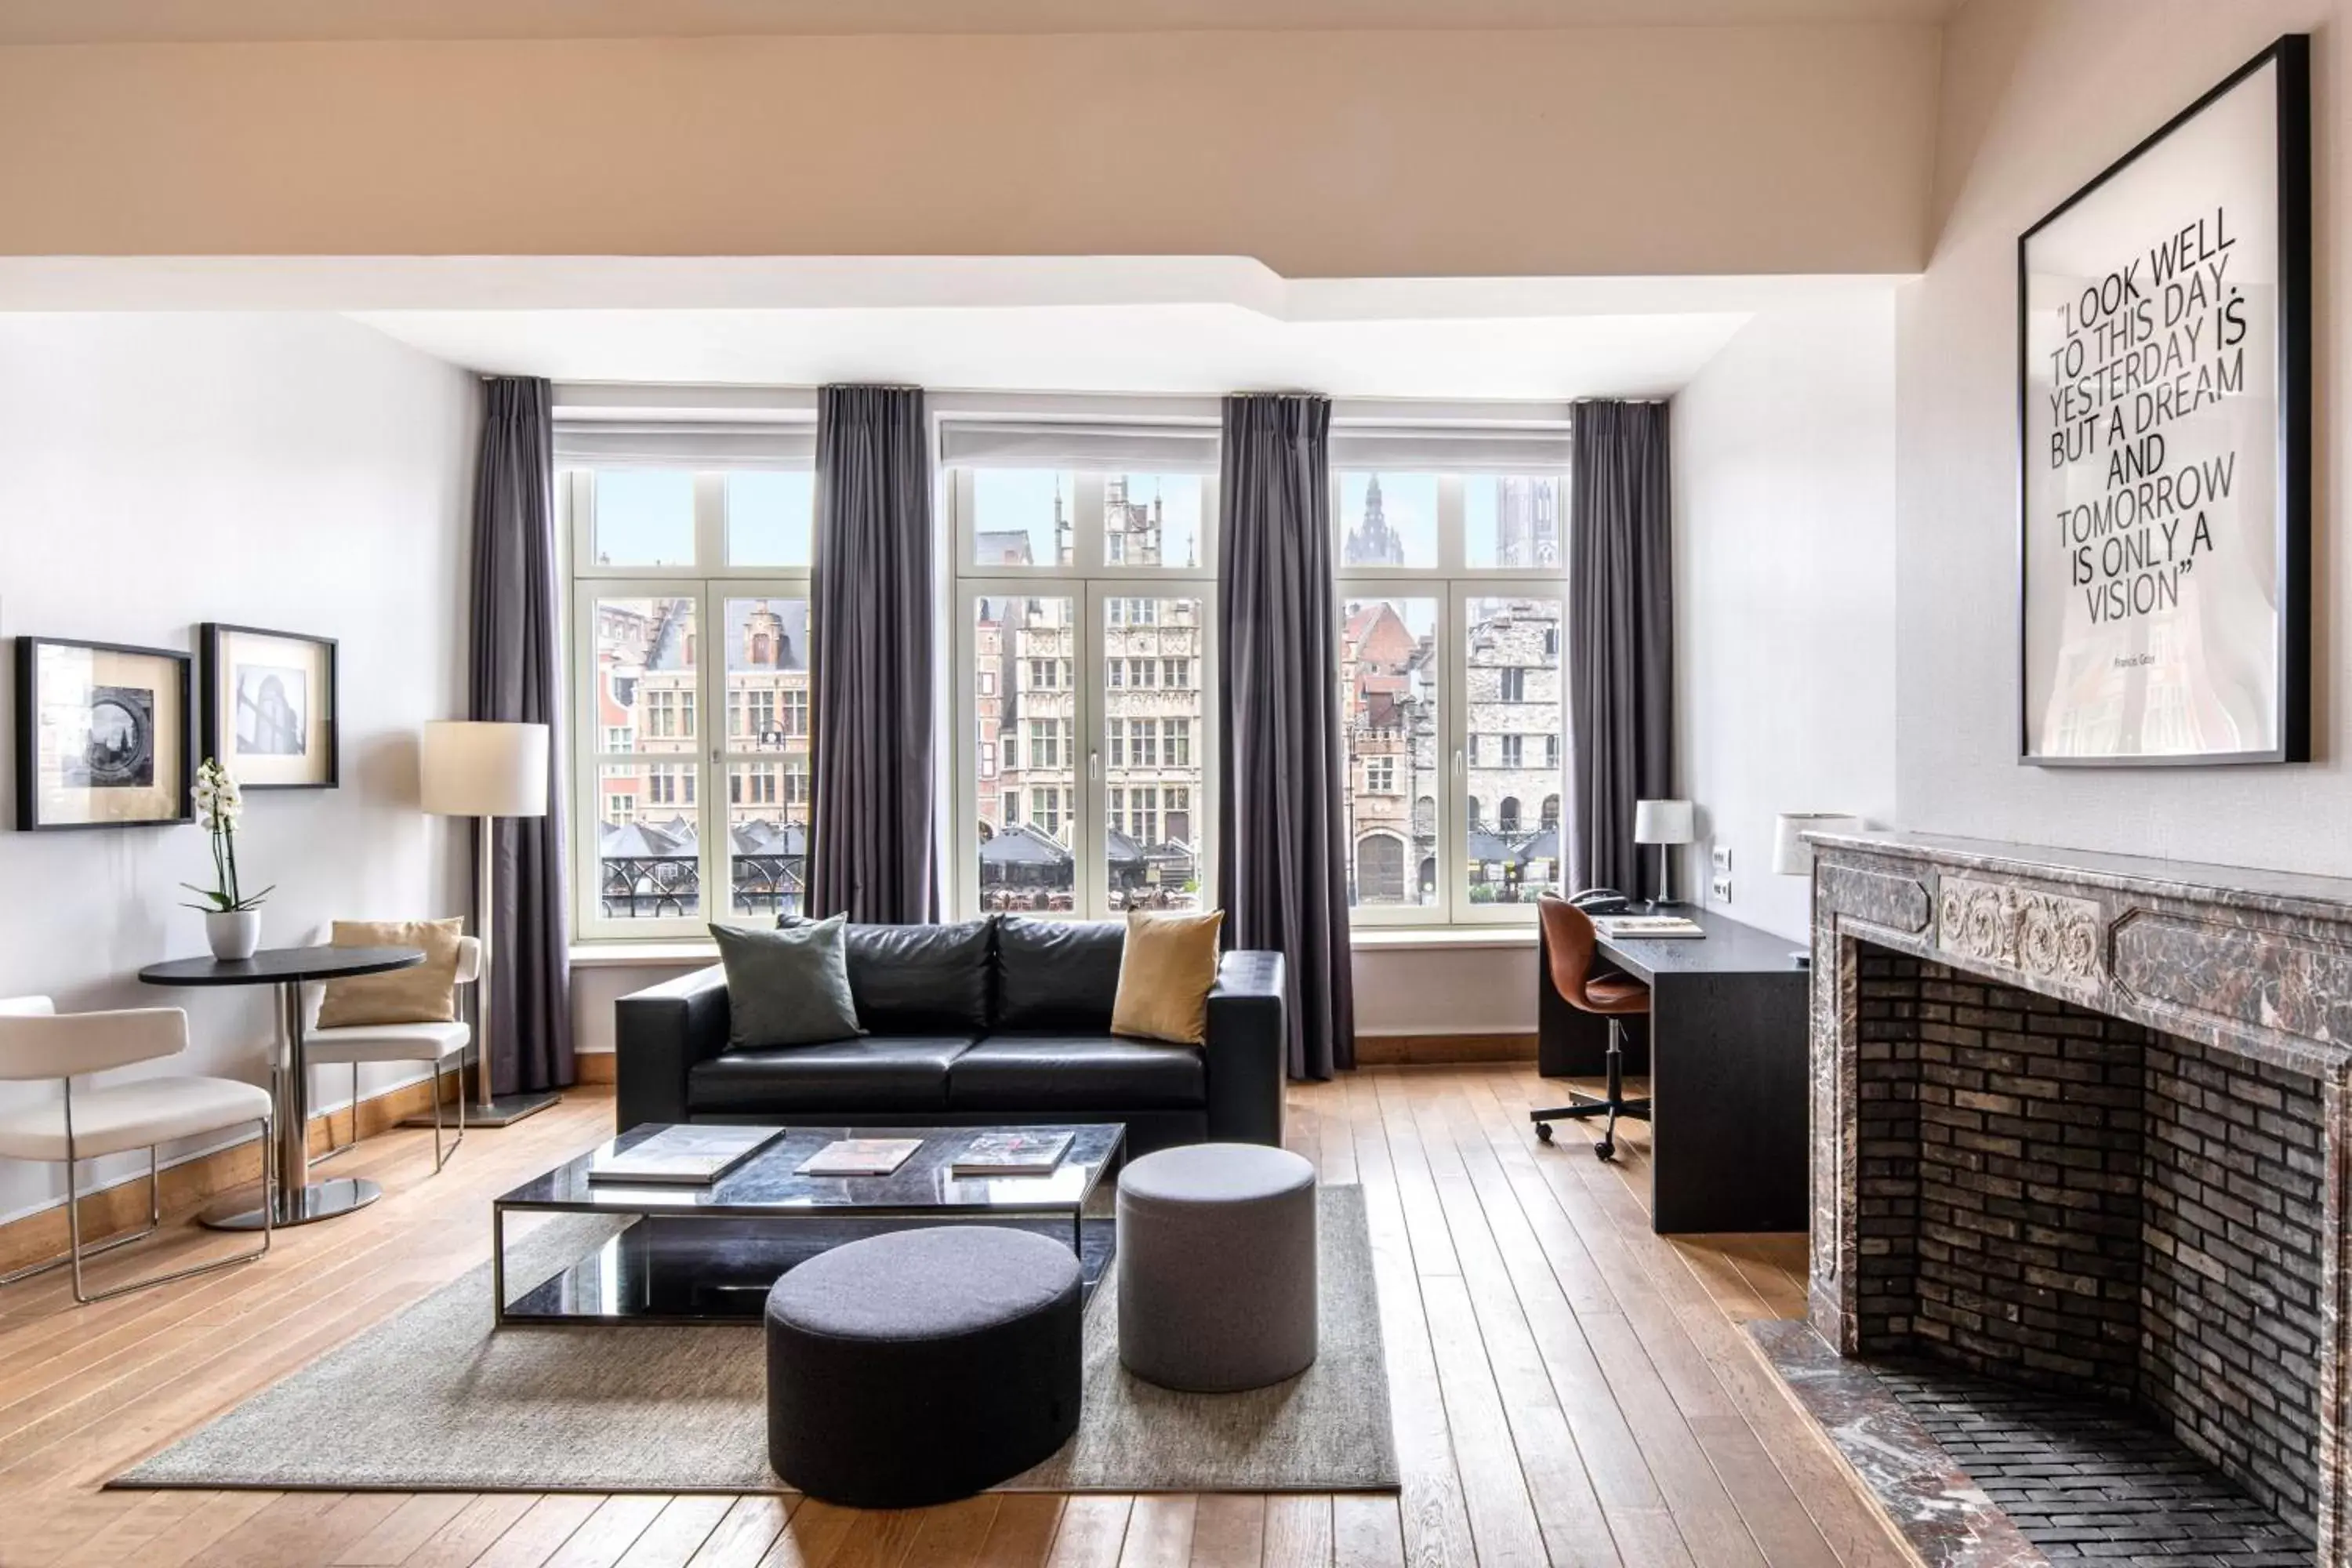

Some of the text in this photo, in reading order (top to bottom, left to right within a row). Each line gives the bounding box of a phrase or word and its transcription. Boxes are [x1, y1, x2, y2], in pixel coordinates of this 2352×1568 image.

[2151, 206, 2236, 288] WELL
[2050, 339, 2083, 387] TO
[2093, 298, 2154, 364] THIS
[2050, 297, 2246, 427] YESTERDAY IS
[2052, 347, 2243, 470] BUT A DREAM
[2056, 451, 2235, 547] TOMORROW
[2107, 434, 2165, 490] AND
[2074, 511, 2213, 586] IS ONLY A
